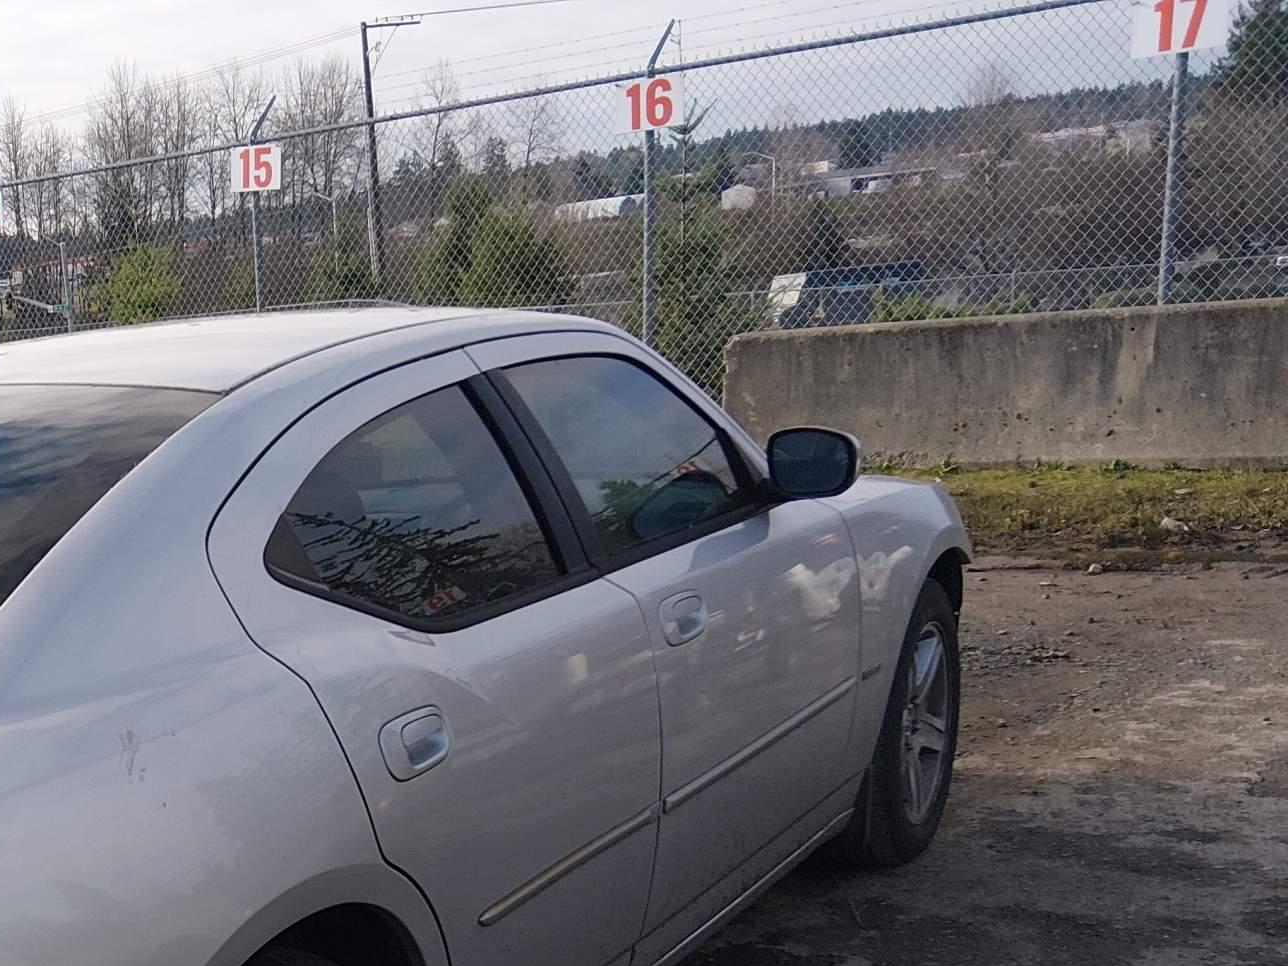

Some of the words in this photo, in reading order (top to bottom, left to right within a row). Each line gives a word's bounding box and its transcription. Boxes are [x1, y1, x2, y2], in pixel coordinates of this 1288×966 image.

[1153, 0, 1209, 52] 17
[625, 77, 673, 131] 16
[239, 147, 273, 189] 15
